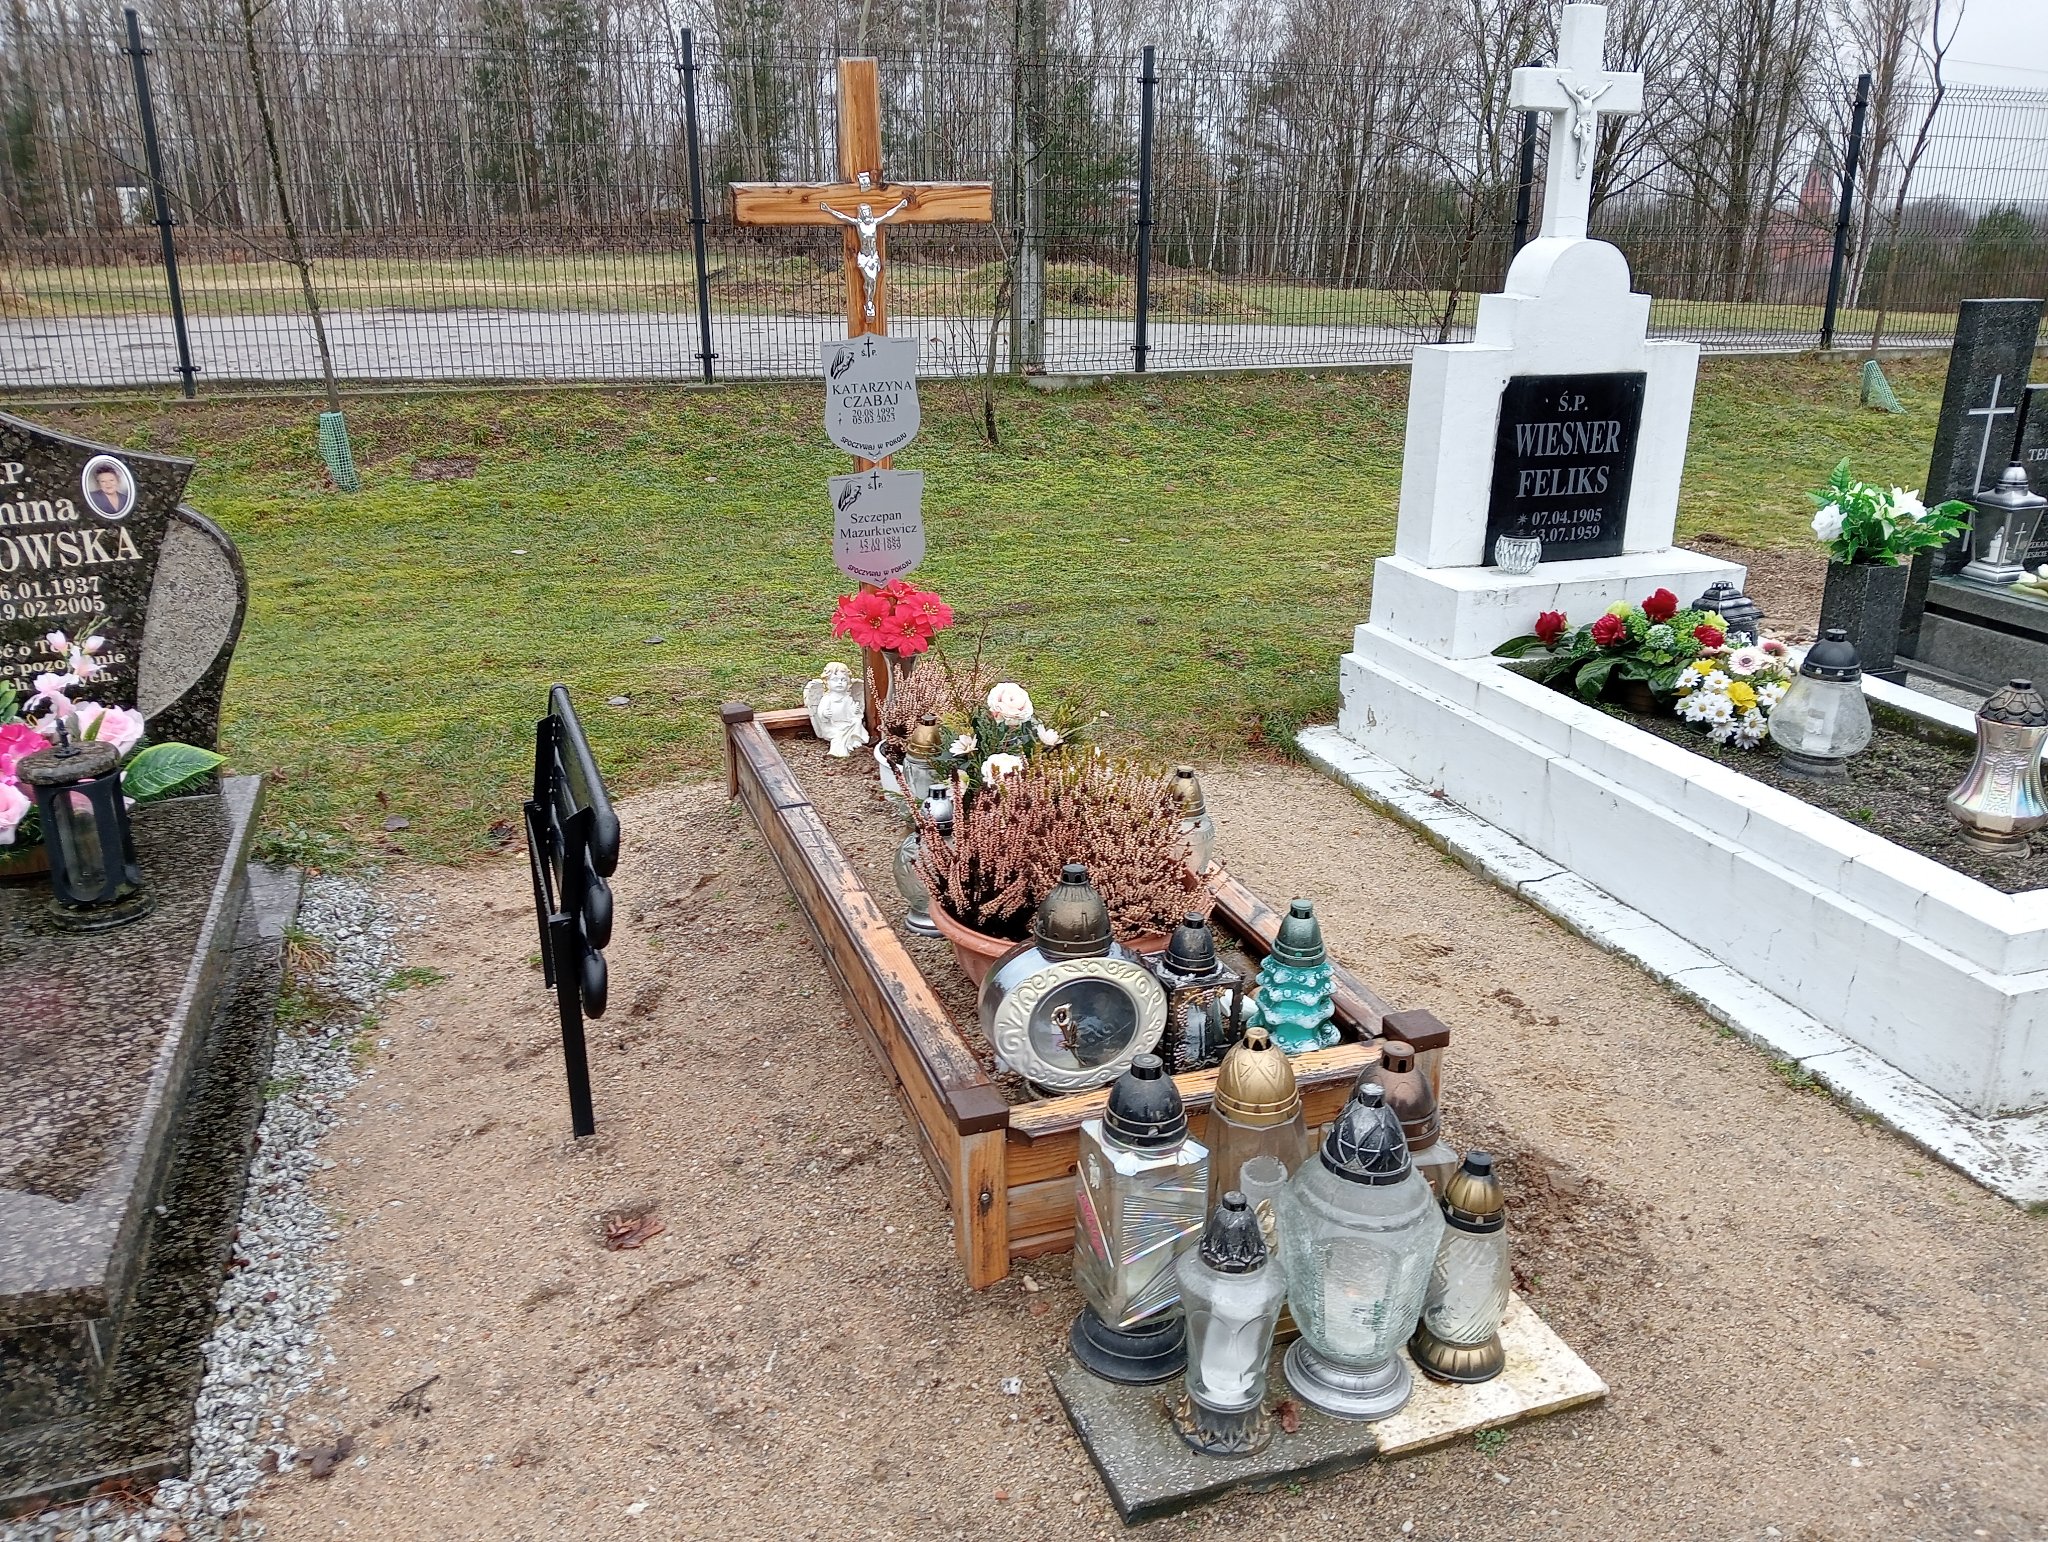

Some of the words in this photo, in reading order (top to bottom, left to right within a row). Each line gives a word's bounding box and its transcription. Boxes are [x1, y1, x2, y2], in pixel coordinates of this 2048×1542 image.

[832, 380, 912, 395] KATARZYNA
[843, 393, 899, 409] CZABAJ
[1558, 390, 1588, 412] Ś.P.
[885, 432, 907, 448] POKOJU
[1515, 420, 1621, 458] WIESNER
[1516, 466, 1610, 498] FELIKS
[850, 511, 902, 525] Szczepan
[1531, 507, 1603, 526] 07.04.1905
[840, 522, 918, 539] Mazurkiewicz
[1530, 525, 1601, 542] 3.07.1959
[0, 526, 143, 573] OWSKA
[891, 559, 912, 574] POKOJU
